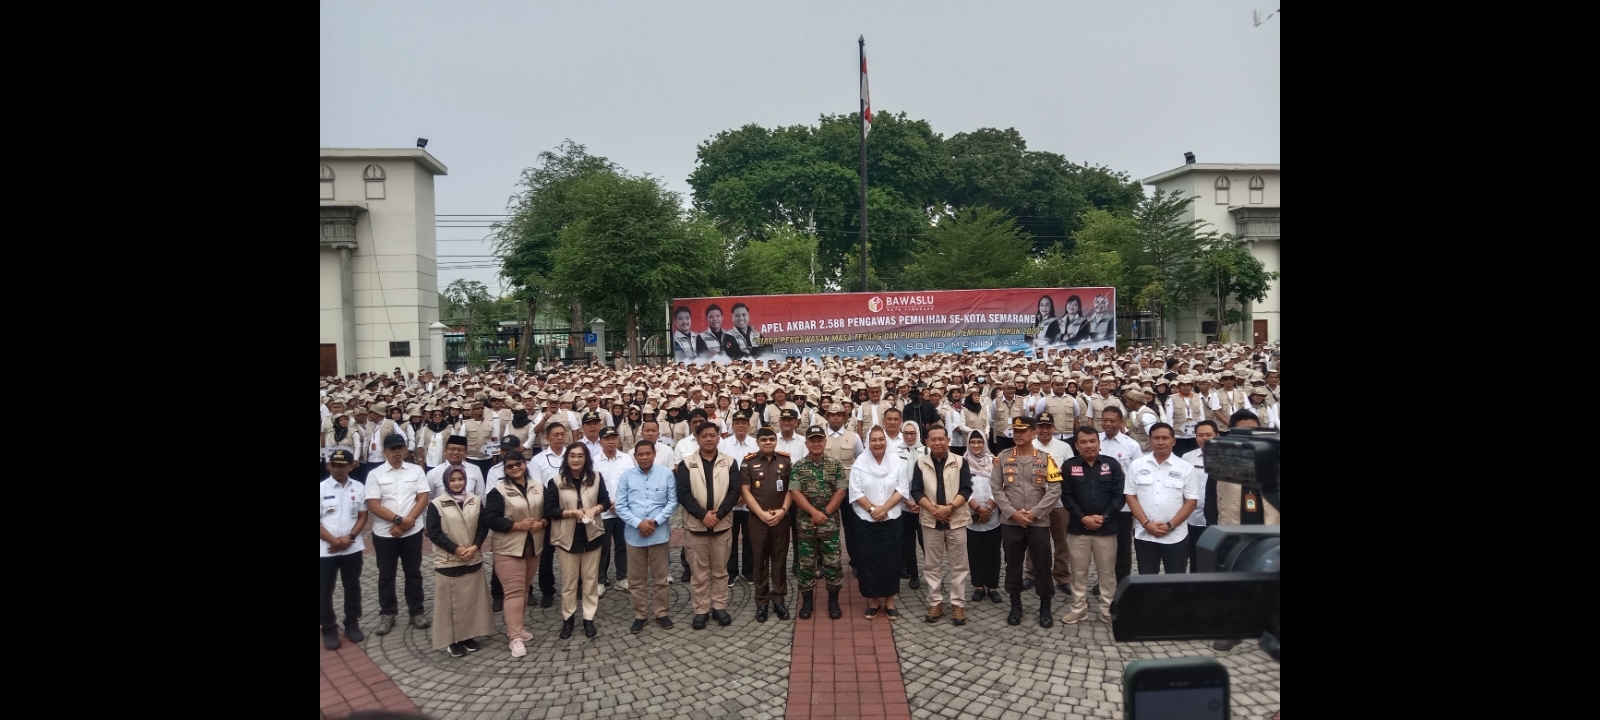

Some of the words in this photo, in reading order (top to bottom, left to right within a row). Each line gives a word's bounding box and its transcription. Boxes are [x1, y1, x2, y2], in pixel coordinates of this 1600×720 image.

[886, 295, 934, 306] BAWASLU
[761, 322, 784, 334] APEL
[786, 320, 817, 332] AKBAR
[819, 318, 845, 329] 2.588
[847, 315, 897, 328] PENGAWAS
[899, 314, 947, 325] PEMILIHAN
[949, 313, 986, 324] SE-KOTA
[988, 313, 1036, 324] SEMARANG
[587, 334, 595, 343] P
[780, 334, 830, 345] PENGAWASAN
[831, 333, 852, 343] MASA
[854, 332, 882, 341] TENANG
[884, 331, 899, 340] DAN
[901, 330, 928, 340] PUNGUT
[930, 329, 956, 339] HITUNG
[958, 328, 998, 337] PEMILIHAN
[999, 327, 1021, 335] TAHUN
[906, 341, 946, 351] SOLID
